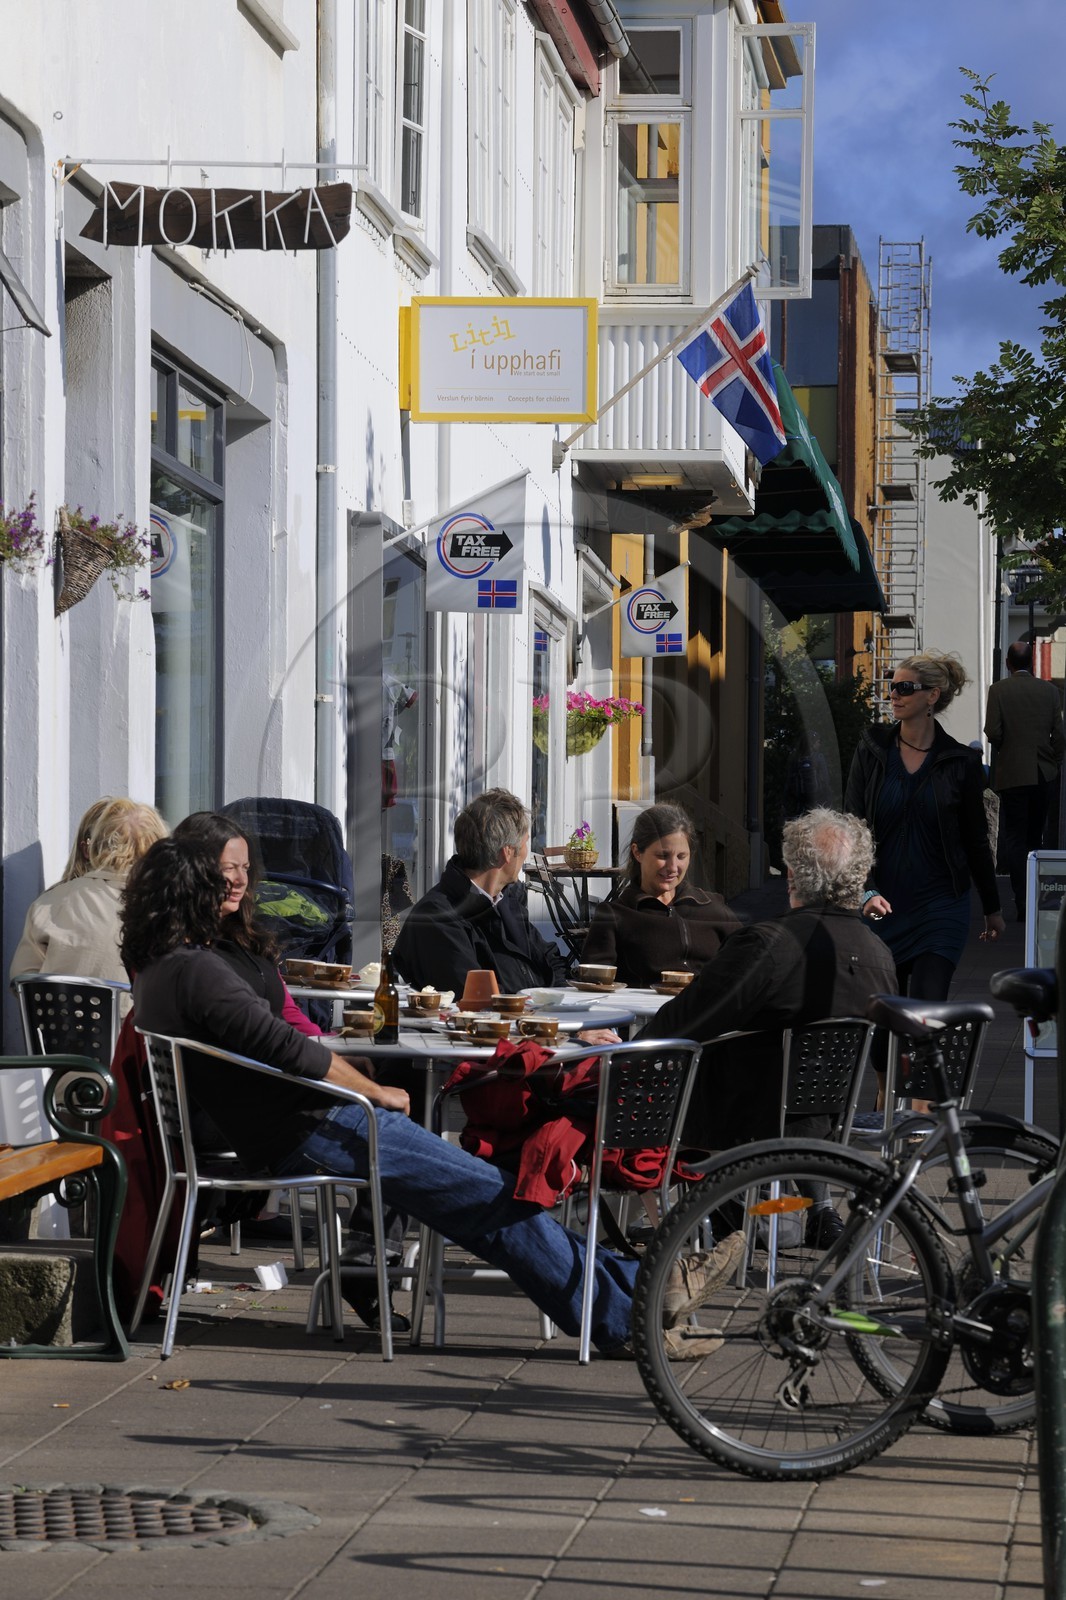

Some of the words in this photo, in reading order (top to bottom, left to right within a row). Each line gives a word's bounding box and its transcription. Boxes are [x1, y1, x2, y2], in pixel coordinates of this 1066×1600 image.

[102, 181, 339, 258] MOKKA
[484, 349, 561, 376] upphafi
[508, 395, 533, 403] Concepts
[456, 535, 486, 546] TAX
[461, 546, 501, 556] FREE
[639, 604, 660, 612] TAX
[643, 611, 670, 619] FREE
